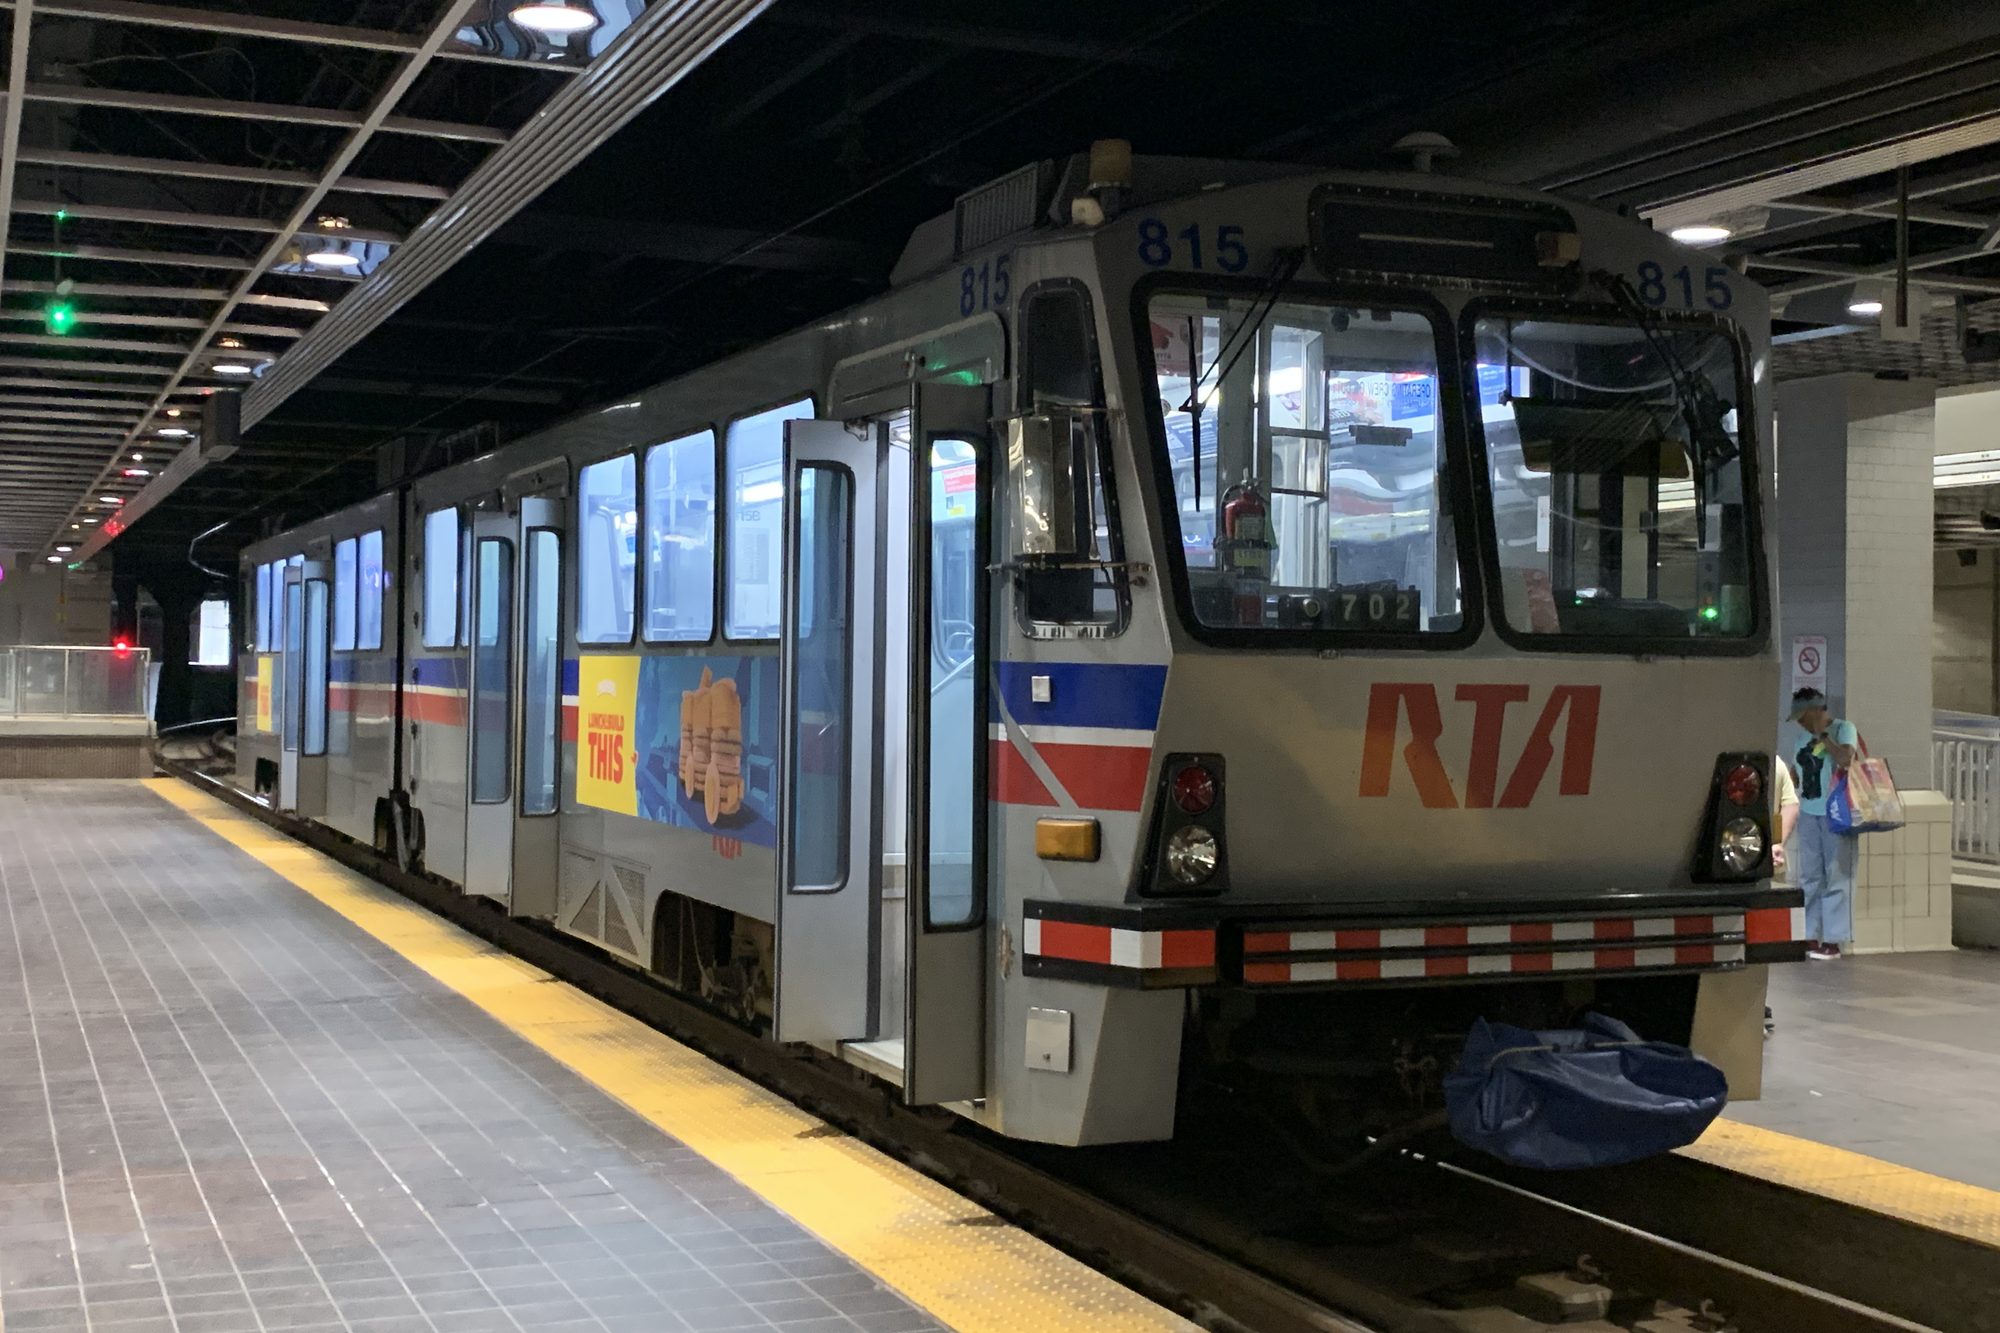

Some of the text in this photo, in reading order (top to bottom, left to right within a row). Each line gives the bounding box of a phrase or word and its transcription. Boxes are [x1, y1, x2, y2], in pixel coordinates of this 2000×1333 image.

[1138, 218, 1249, 272] 815
[960, 255, 1010, 317] 815
[1637, 261, 1732, 310] 815
[1341, 594, 1410, 620] 702
[588, 732, 624, 784] THIS
[1359, 683, 1601, 808] RTA
